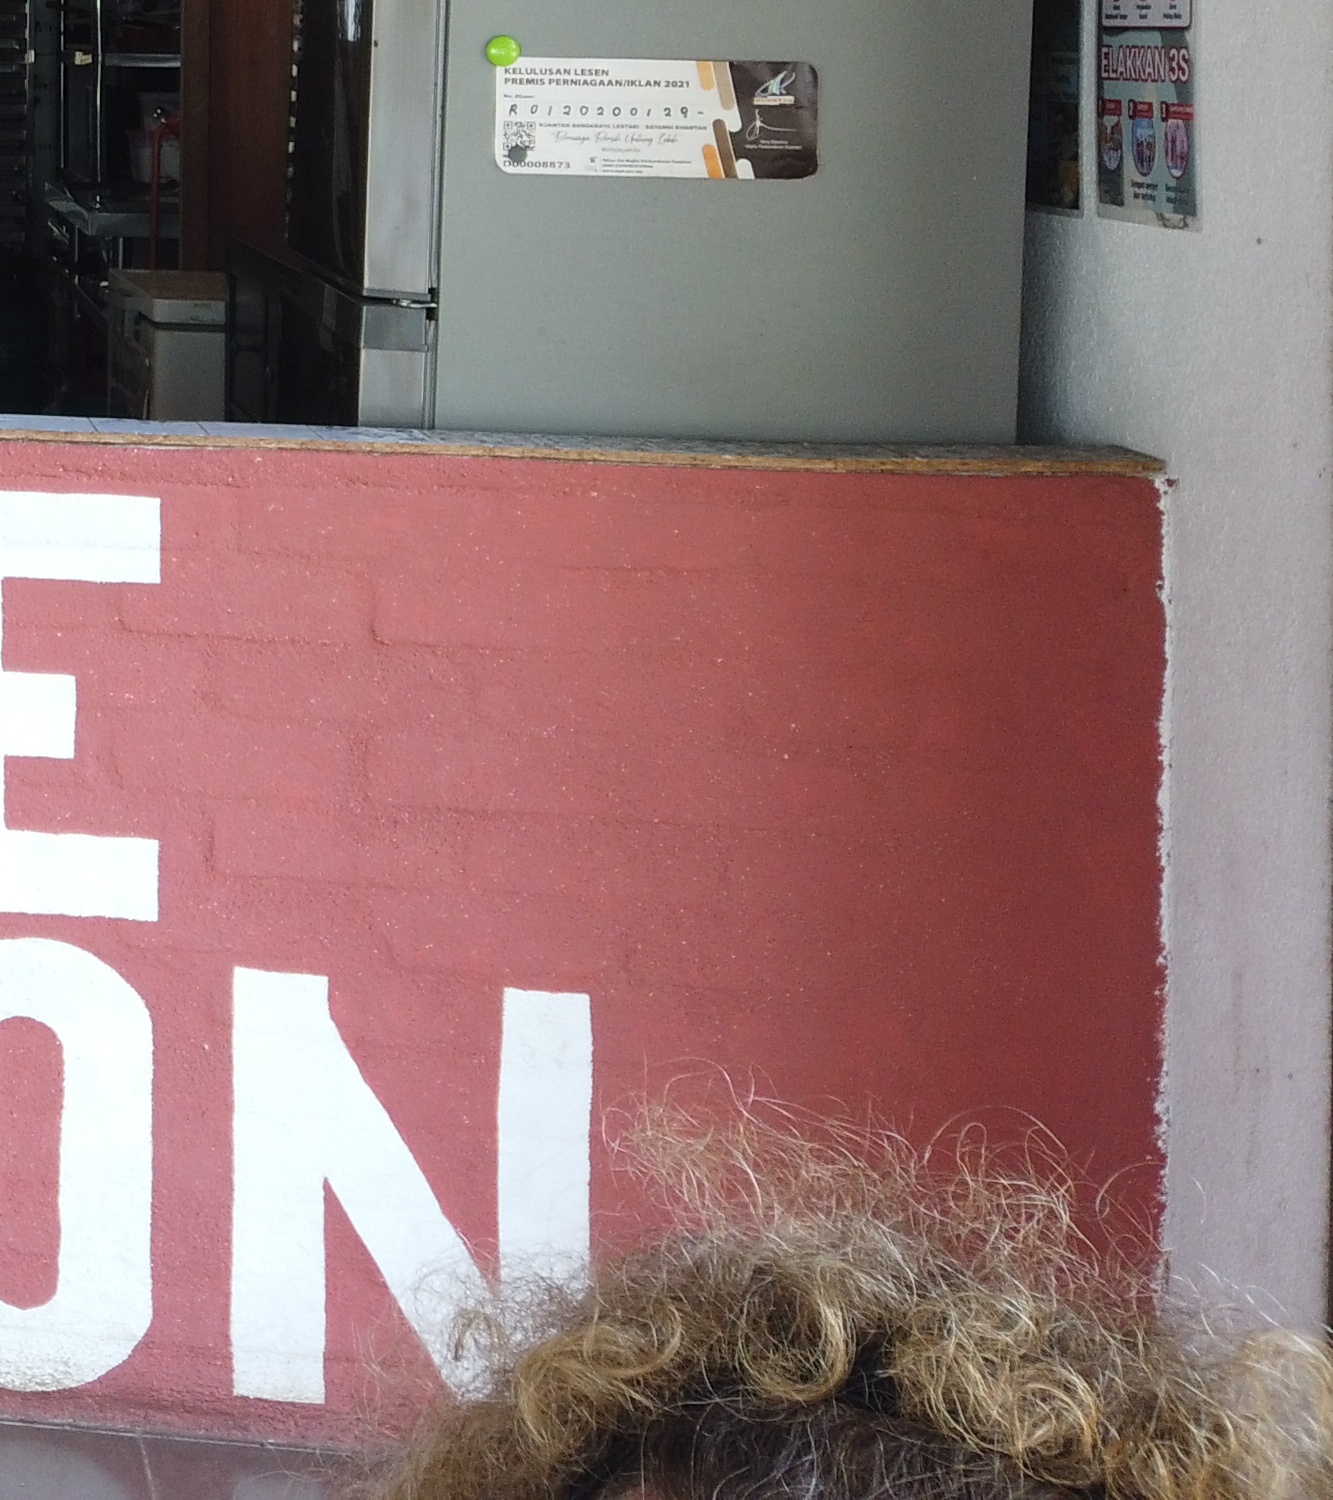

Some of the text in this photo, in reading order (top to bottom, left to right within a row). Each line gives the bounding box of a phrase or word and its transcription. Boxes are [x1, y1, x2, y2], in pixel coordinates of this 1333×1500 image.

[1100, 45, 1190, 82] ELAKKAN 3S
[504, 67, 609, 77] KELULUSAN LESEN
[504, 77, 690, 88] PREMIS PERNIAGAAN/IKLAN 2021
